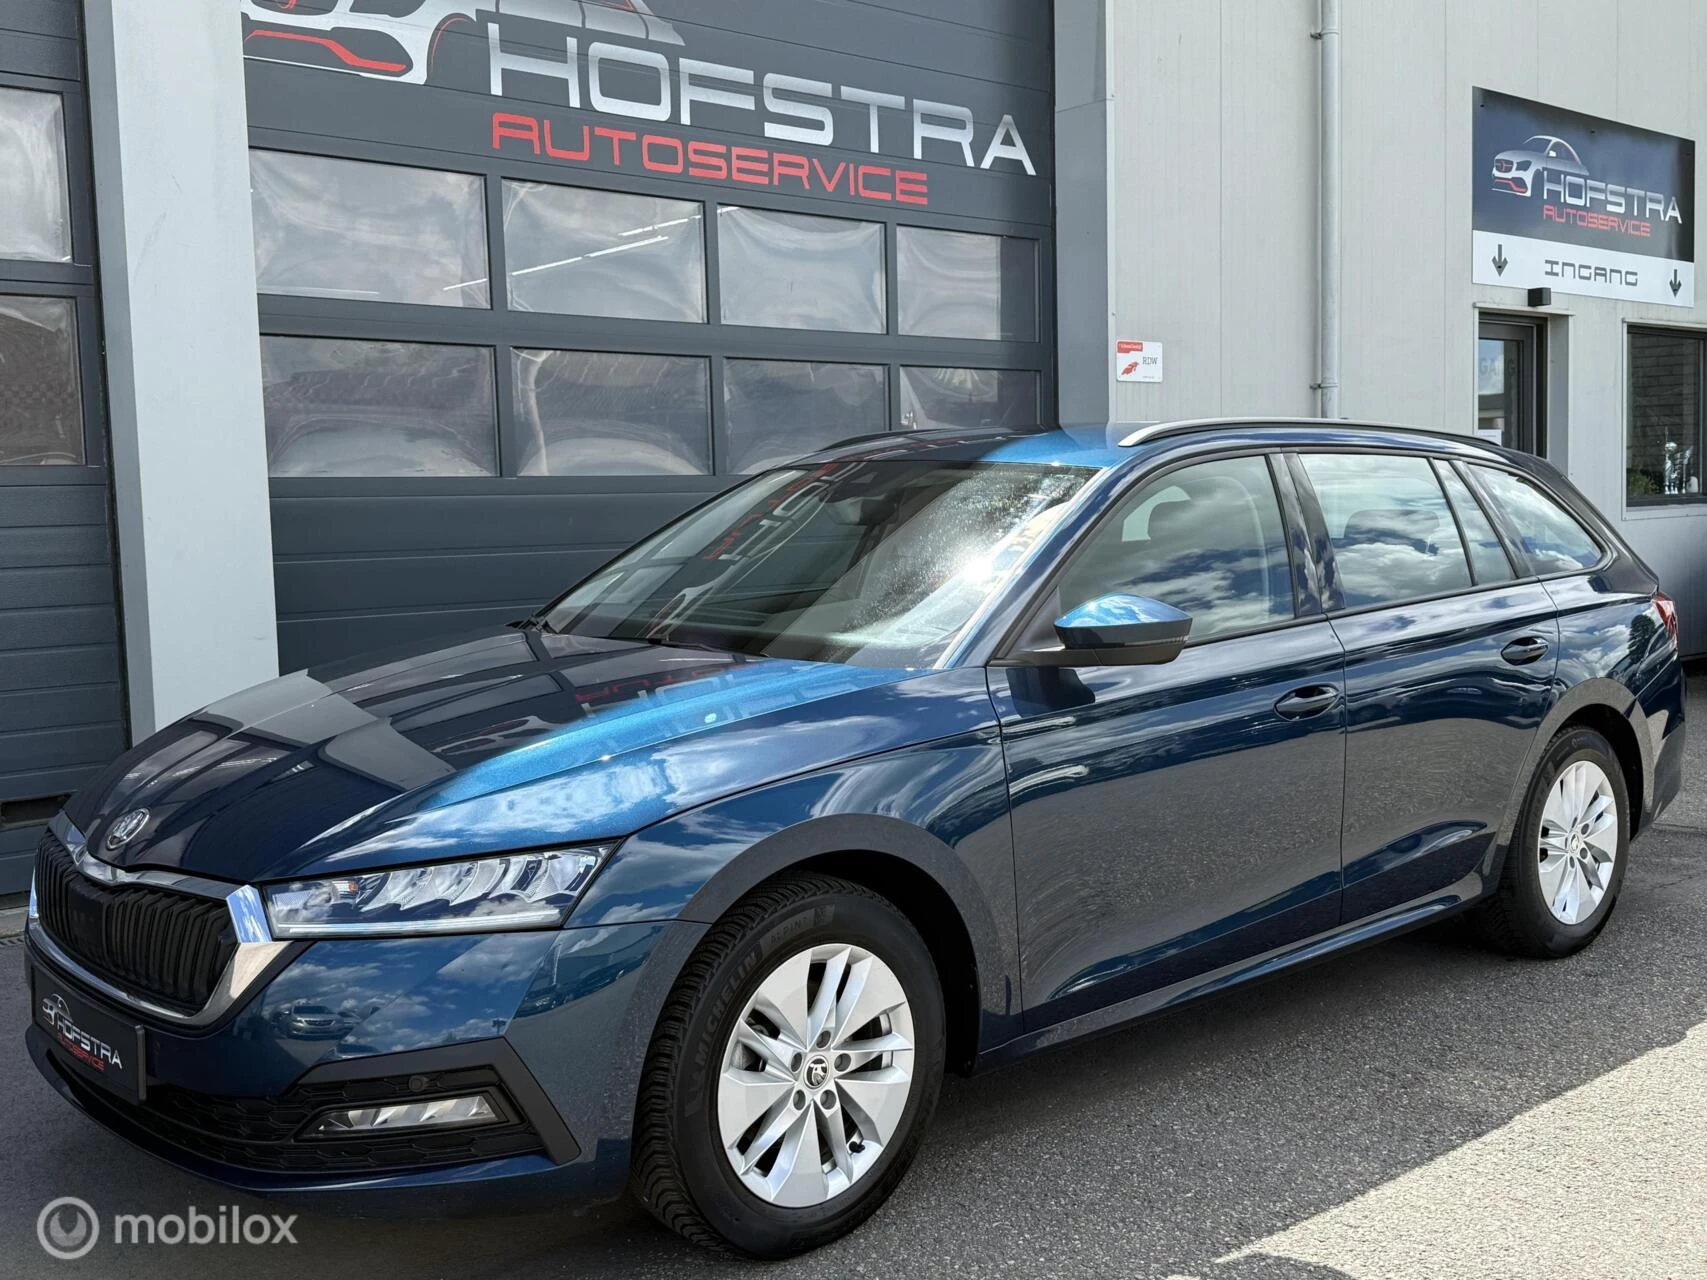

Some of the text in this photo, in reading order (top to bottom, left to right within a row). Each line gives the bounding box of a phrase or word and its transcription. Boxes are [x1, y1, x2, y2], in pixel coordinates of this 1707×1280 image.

[488, 22, 1037, 176] HOFSTRA
[491, 112, 928, 205] AUTOSERVICE
[1543, 170, 1683, 224] HOFSTRA
[1543, 204, 1651, 237] AUTOSERVICE
[1544, 258, 1639, 287] INGANG
[694, 950, 759, 1068] MICHELIN
[57, 1013, 123, 1070] HOFSTRA
